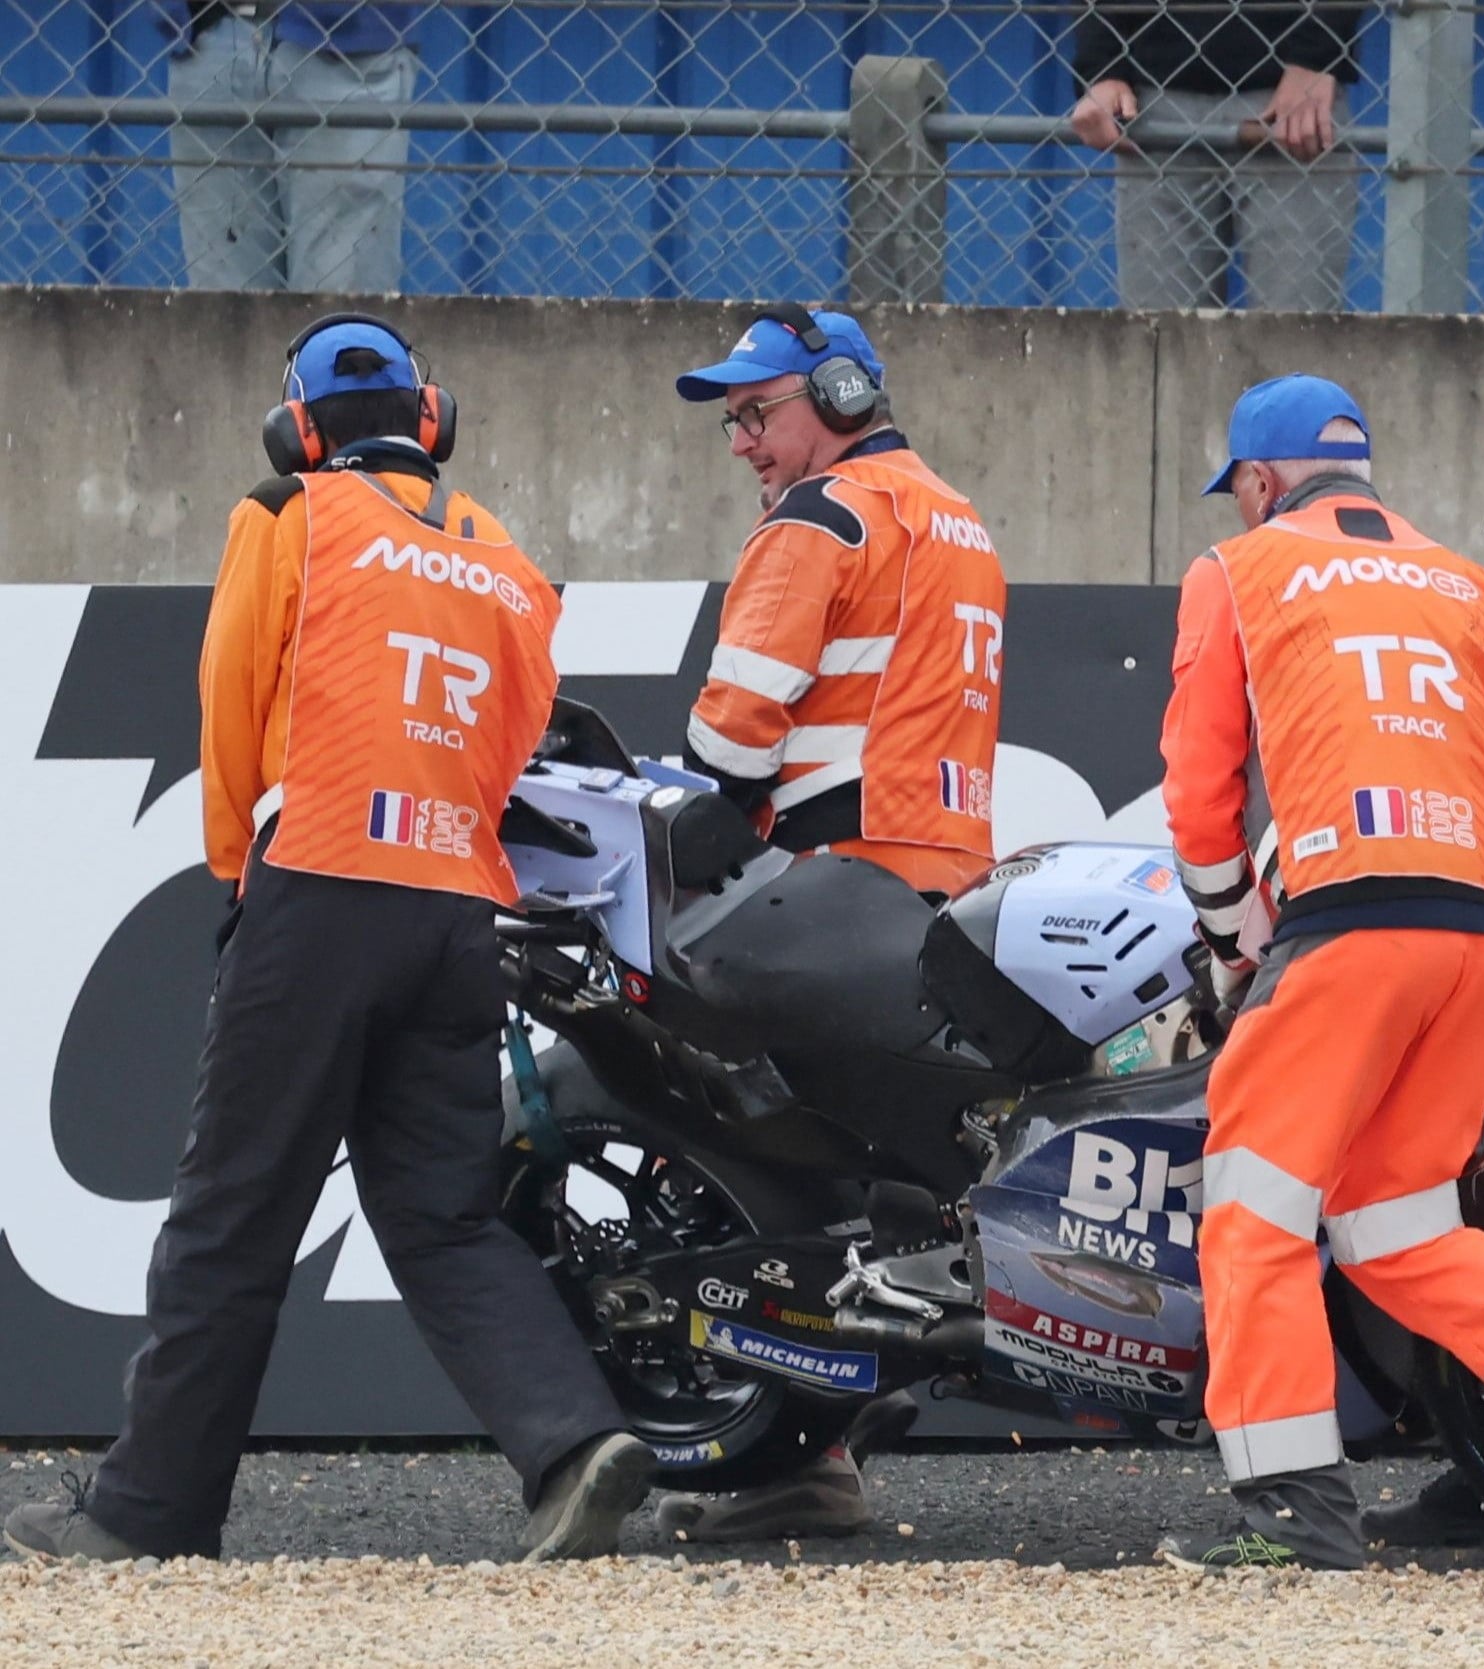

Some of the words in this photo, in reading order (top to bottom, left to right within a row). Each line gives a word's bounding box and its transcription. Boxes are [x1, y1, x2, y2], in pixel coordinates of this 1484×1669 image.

[931, 508, 997, 558] Moto
[1280, 556, 1479, 603] MotoGP
[386, 631, 492, 728] TR
[1333, 634, 1465, 712] TR
[963, 688, 989, 715] TRAC
[1370, 714, 1448, 742] TRACK
[1041, 914, 1101, 932] DUCATI
[1058, 1215, 1157, 1269] NEWS
[741, 1338, 860, 1378] MICHELIN
